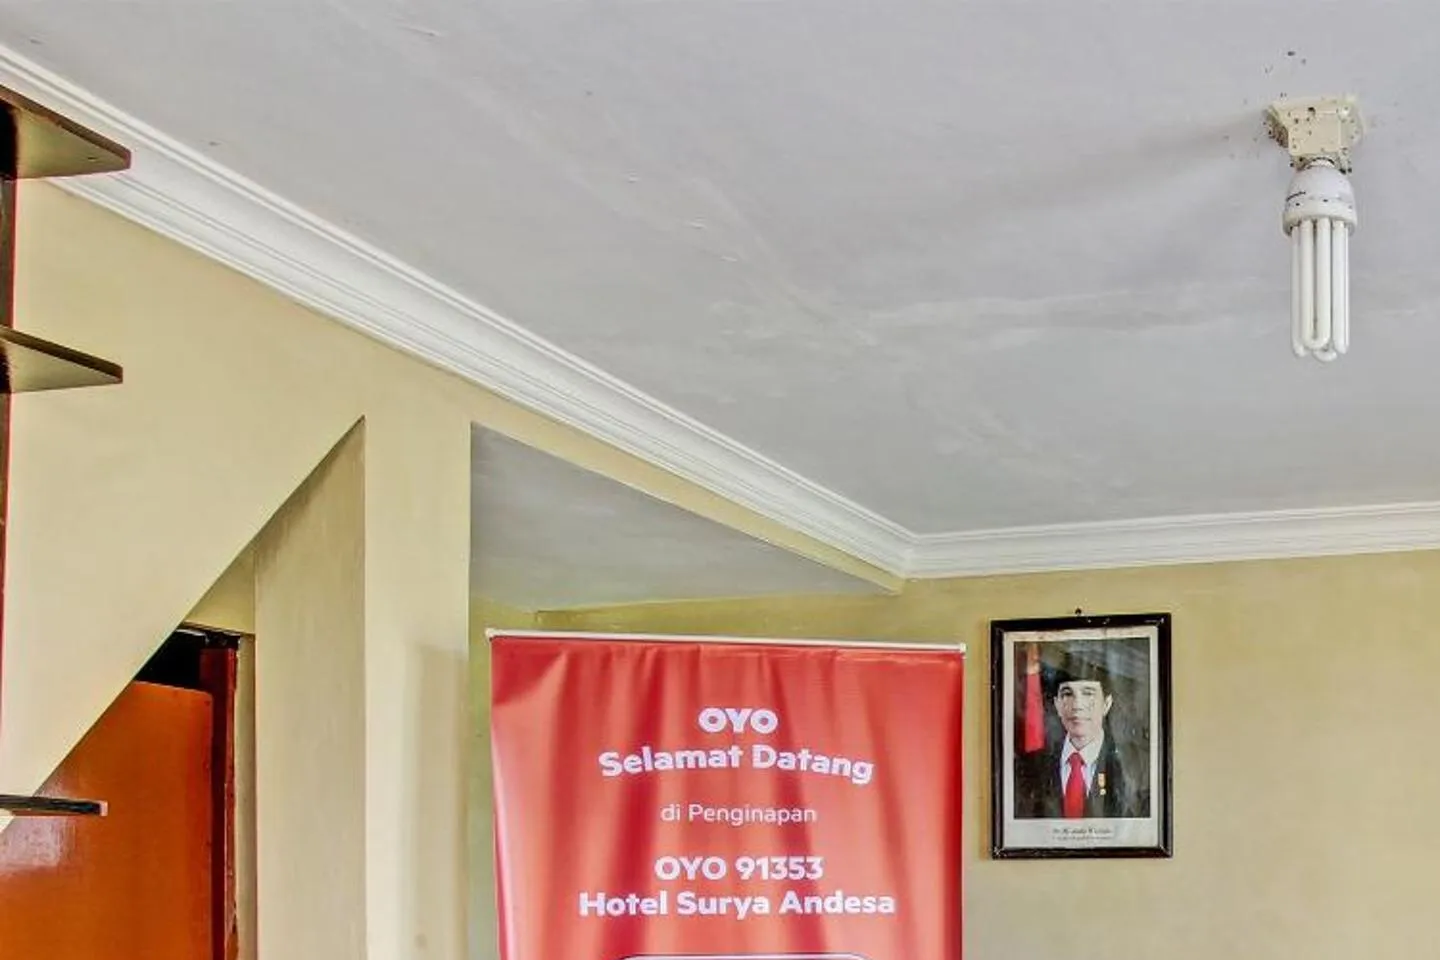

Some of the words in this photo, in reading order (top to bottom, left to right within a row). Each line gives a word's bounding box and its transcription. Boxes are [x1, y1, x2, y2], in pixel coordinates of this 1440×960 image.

[699, 707, 778, 734] OYO
[598, 744, 743, 777] Selamat
[752, 744, 874, 783] Datang
[661, 804, 681, 822] di
[688, 804, 817, 826] Penginapan
[654, 856, 726, 880] OYO
[736, 856, 824, 880] 91353
[579, 891, 668, 916] Hotel
[677, 891, 770, 920] Surya
[779, 891, 895, 915] Andesa
